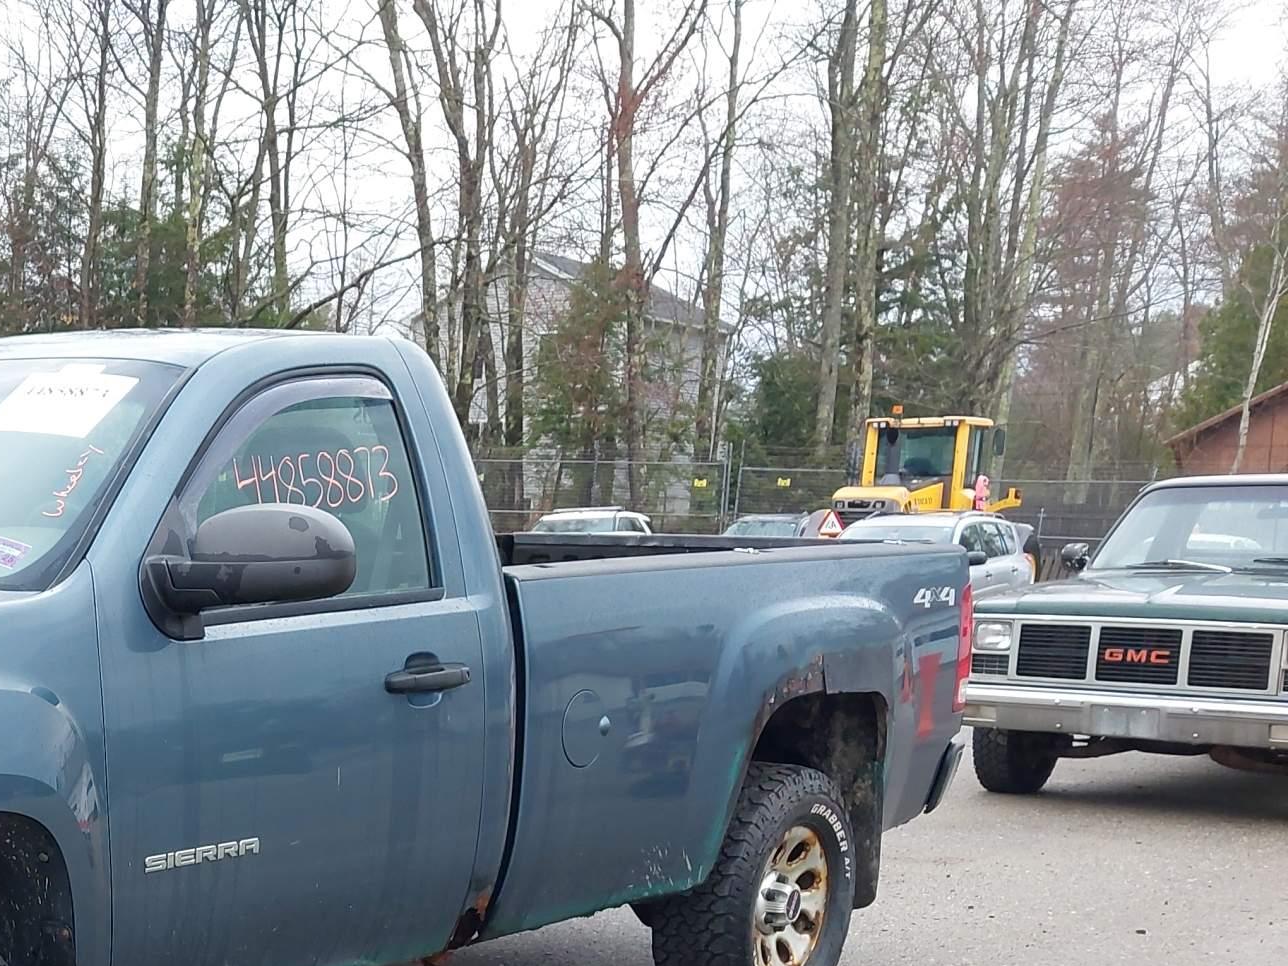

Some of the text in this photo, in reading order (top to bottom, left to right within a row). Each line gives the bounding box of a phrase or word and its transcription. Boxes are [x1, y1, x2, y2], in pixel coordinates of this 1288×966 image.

[232, 445, 399, 508] 44858873
[1104, 648, 1171, 664] GMC
[811, 803, 849, 853] GRABBER
[144, 837, 260, 873] SIERRA
